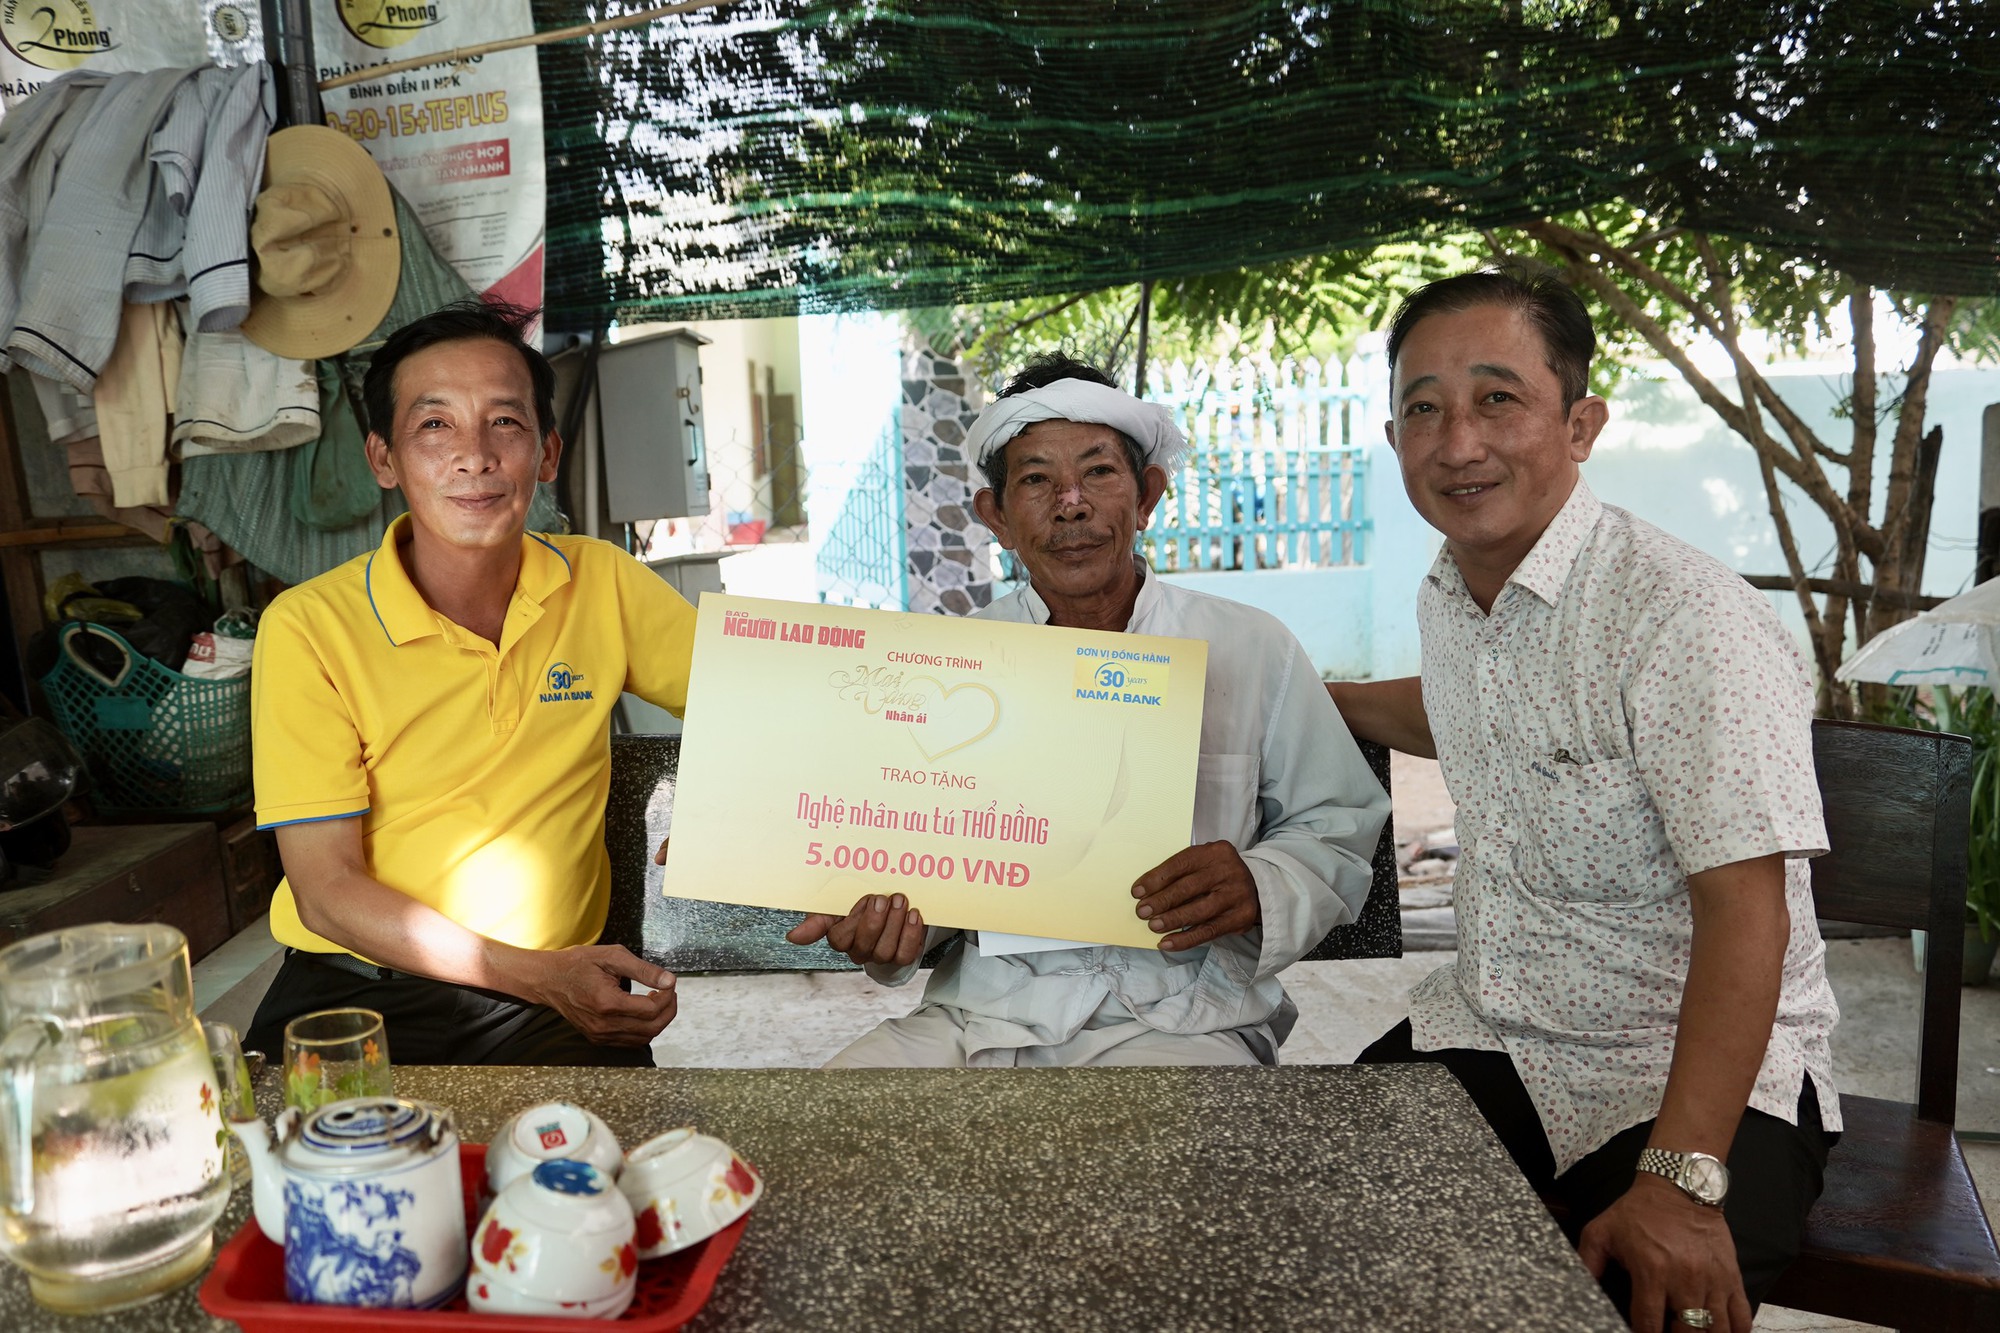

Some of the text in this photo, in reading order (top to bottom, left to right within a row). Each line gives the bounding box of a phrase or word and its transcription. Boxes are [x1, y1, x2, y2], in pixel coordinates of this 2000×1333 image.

[386, 4, 437, 24] Phong
[53, 28, 112, 48] Phong
[0, 78, 42, 97] HÂN
[349, 84, 383, 99] BÌNH
[387, 75, 418, 96] ĐIỀN
[477, 145, 505, 160] HỢP
[462, 161, 505, 176] NHANH
[723, 616, 866, 650] NGƯỜI LAO ĐỘNG
[887, 651, 983, 671] CHƯƠNG TRÌNH
[1076, 647, 1098, 657] ĐƠN
[1100, 649, 1110, 661] VỊ
[1142, 652, 1171, 664] HÀNH
[551, 669, 571, 690] 30
[1099, 669, 1148, 688] 30 years
[539, 690, 594, 703] NAM A BANK
[1076, 688, 1162, 706] NAM A BANK
[885, 709, 927, 724] Nhân ái
[880, 766, 976, 790] TRAO TẶNG
[797, 792, 1049, 845] Nghệ nhân ưu tú THỔ ĐỒNG
[805, 842, 1030, 888] 5.000.000 VNĐ
